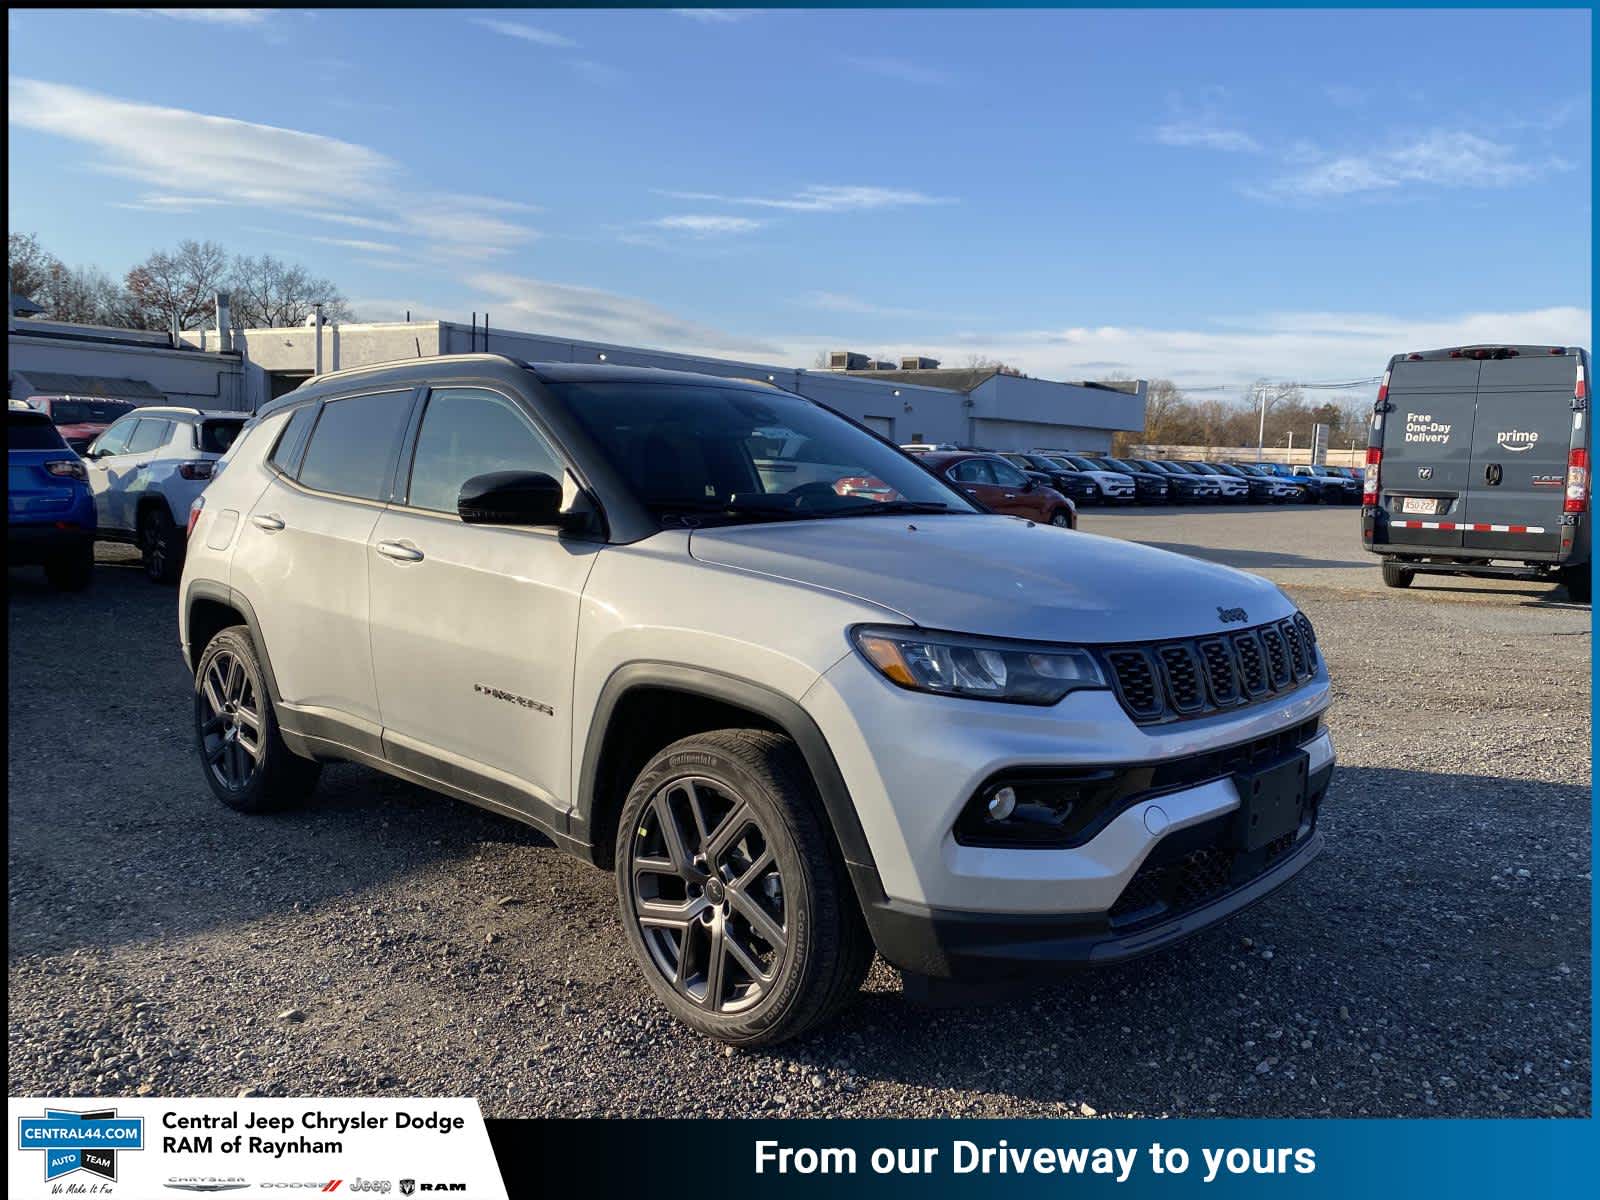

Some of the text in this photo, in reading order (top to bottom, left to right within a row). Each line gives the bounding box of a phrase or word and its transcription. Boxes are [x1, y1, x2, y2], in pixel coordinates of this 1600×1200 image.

[1407, 413, 1431, 422] Free
[1406, 422, 1451, 434] One-Day
[1405, 432, 1449, 444] Delivery
[1497, 429, 1538, 444] prime
[1216, 606, 1248, 623] Jeep
[474, 683, 554, 717] COMPASS
